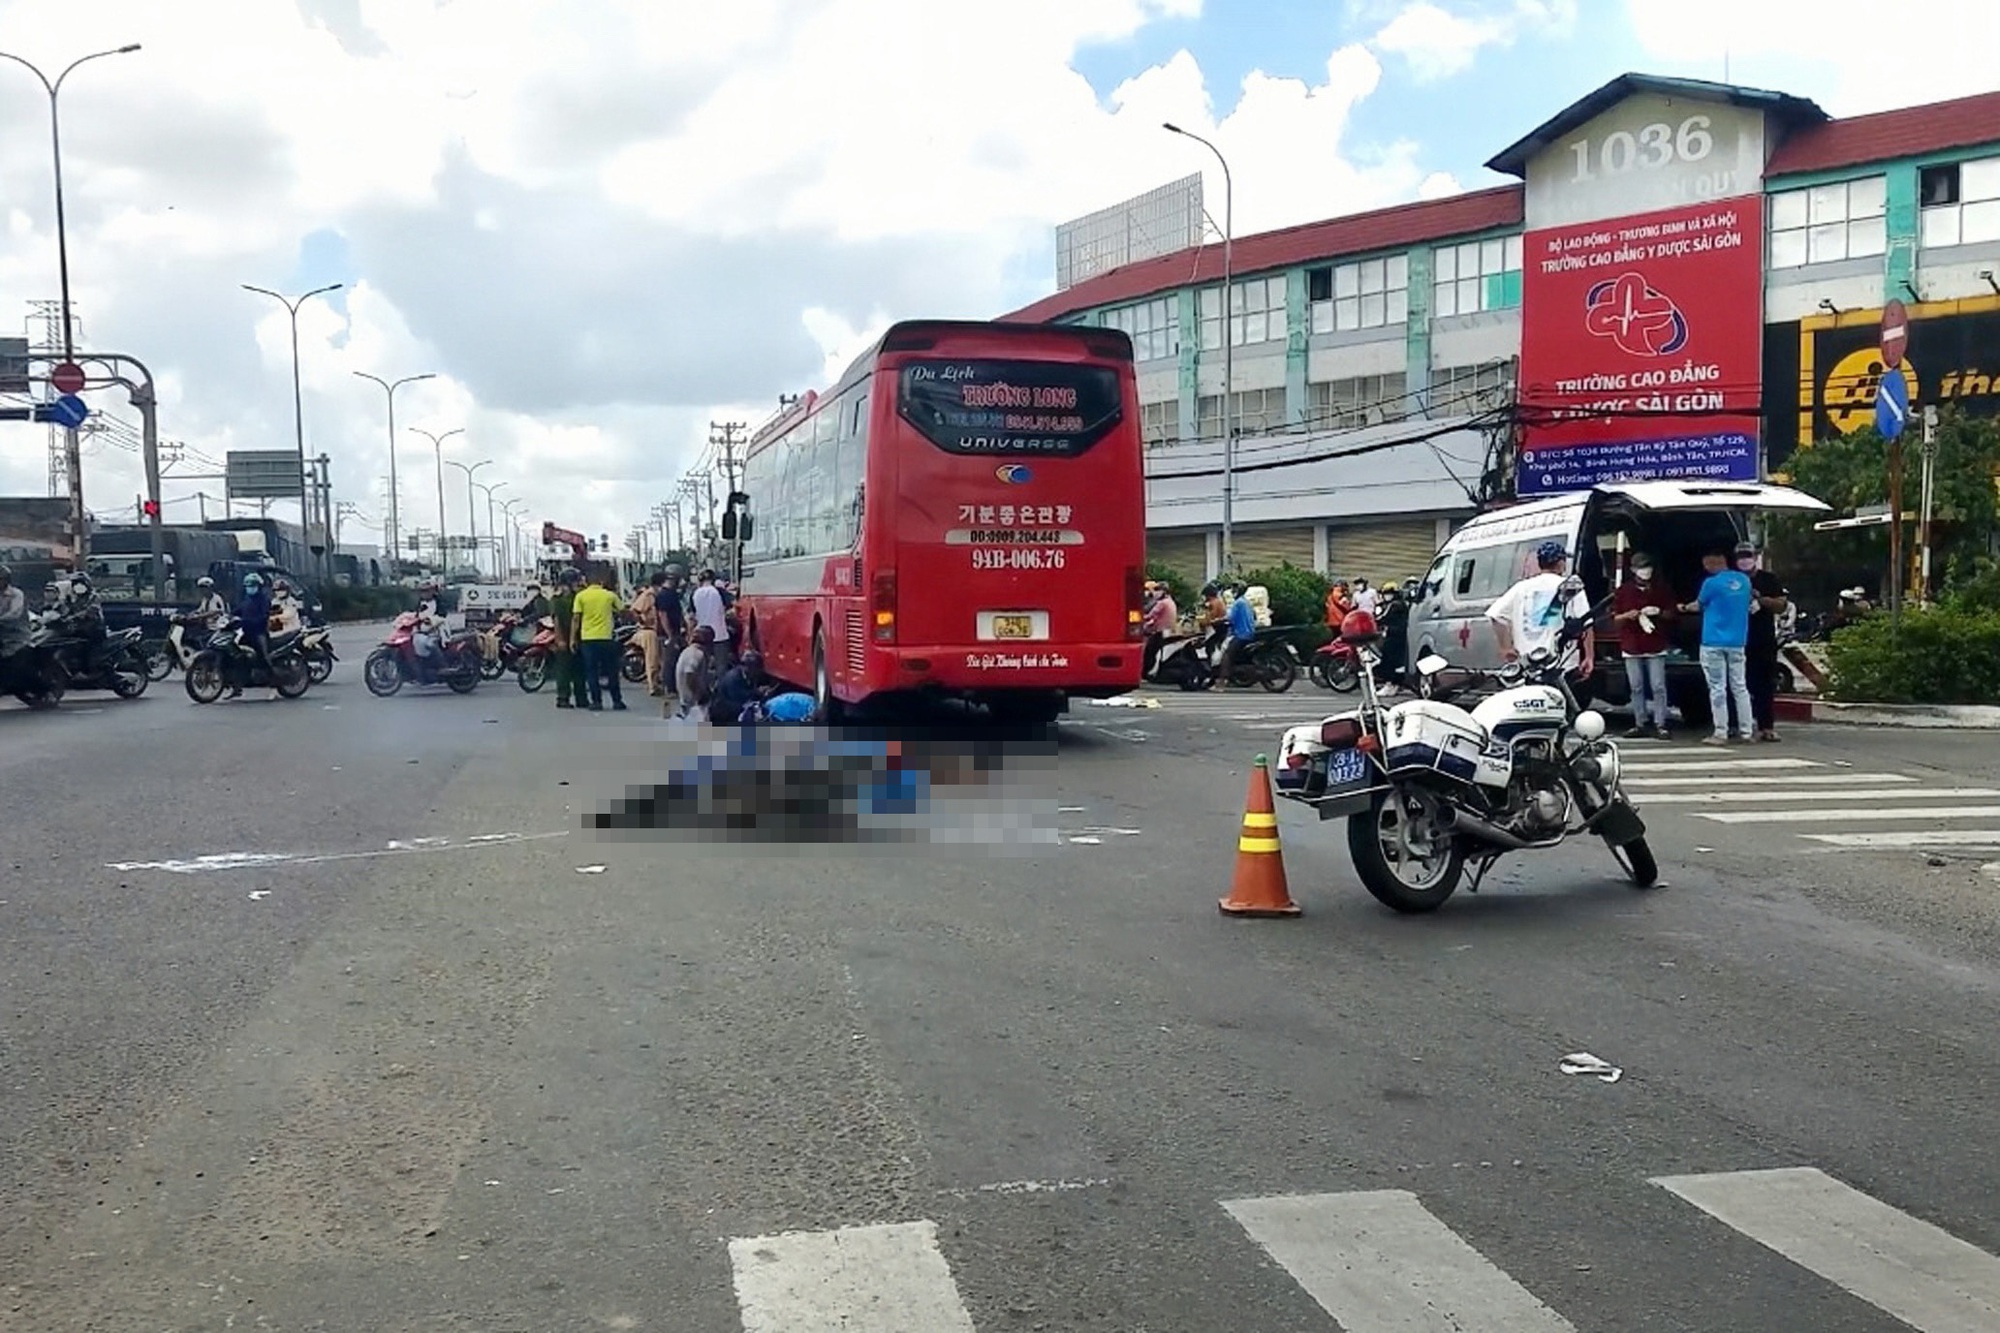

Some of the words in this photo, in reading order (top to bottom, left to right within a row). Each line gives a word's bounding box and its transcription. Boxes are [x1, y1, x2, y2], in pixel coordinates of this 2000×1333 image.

[1570, 115, 1713, 183] 1036
[1549, 237, 1563, 253] BỘ
[1563, 237, 1582, 250] LAO
[1687, 216, 1700, 231] VÀ
[1717, 211, 1737, 229] HỘI
[1540, 250, 1587, 273] TRƯỜNG
[1588, 252, 1611, 268] CAO
[1647, 245, 1656, 259] Y
[1693, 235, 1712, 251] SÀI
[1714, 232, 1741, 248] GÒN
[910, 366, 936, 381] Du
[1555, 373, 1627, 395] TRƯỜNG
[1631, 370, 1666, 388] CAO
[1669, 359, 1720, 384] ĐẲNG
[1033, 387, 1078, 409] LONG
[1635, 391, 1669, 412] SÀI
[1676, 387, 1724, 411] GÒN
[959, 437, 1070, 449] UNIVERSE
[972, 550, 1065, 570] 94B-006.76
[1513, 699, 1545, 708] CSGT
